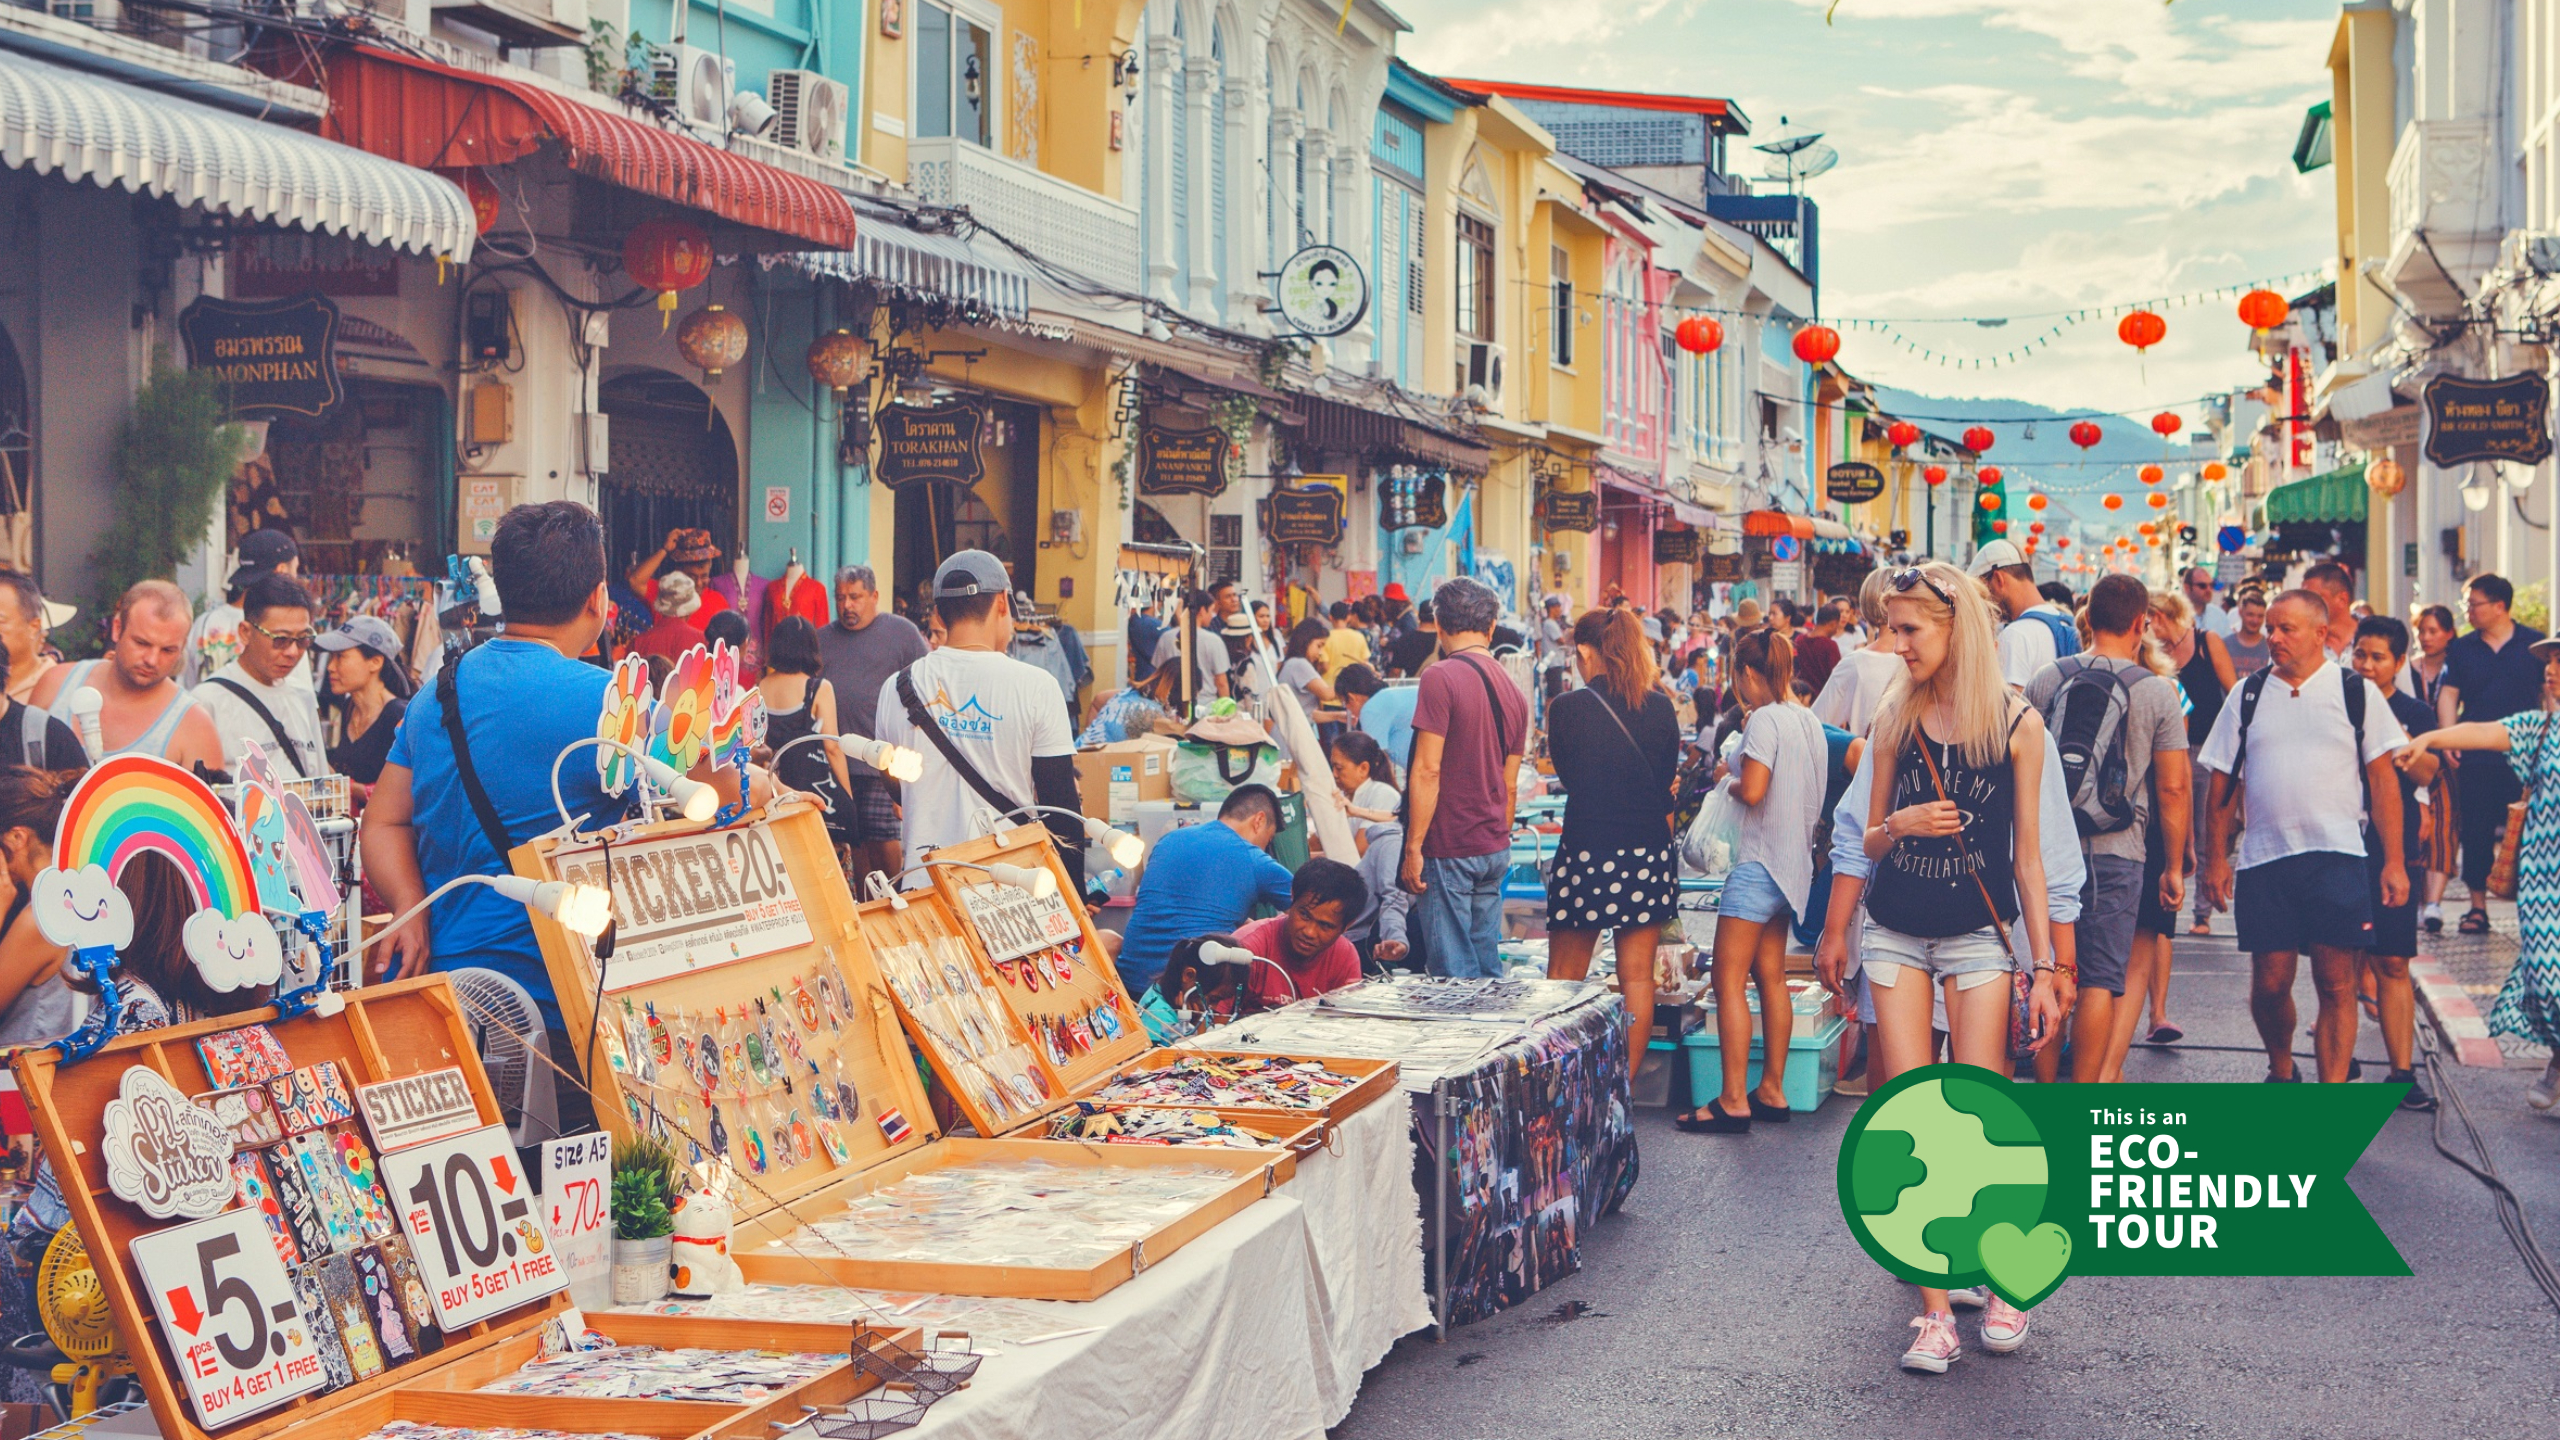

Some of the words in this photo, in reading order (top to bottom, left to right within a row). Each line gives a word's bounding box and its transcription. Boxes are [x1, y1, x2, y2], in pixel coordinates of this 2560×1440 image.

[891, 440, 969, 454] TORAKHAN
[1968, 774, 1996, 804] MY
[744, 908, 759, 922] BUY
[757, 902, 766, 919] 5
[765, 903, 779, 918] GET
[783, 899, 801, 914] FREE
[976, 901, 1045, 954] PATCH
[364, 1070, 473, 1126] STICKER
[131, 1131, 223, 1205] Sticker
[588, 1136, 608, 1164] A5
[441, 1283, 471, 1311] BUY
[471, 1272, 485, 1300] 5
[484, 1268, 509, 1295] GET
[509, 1260, 522, 1285] 1
[521, 1254, 557, 1282] FREE
[202, 1385, 231, 1413] BUY
[233, 1375, 246, 1400] 4
[246, 1370, 275, 1396] GET
[273, 1360, 286, 1385] 1
[286, 1354, 320, 1382] FREE
